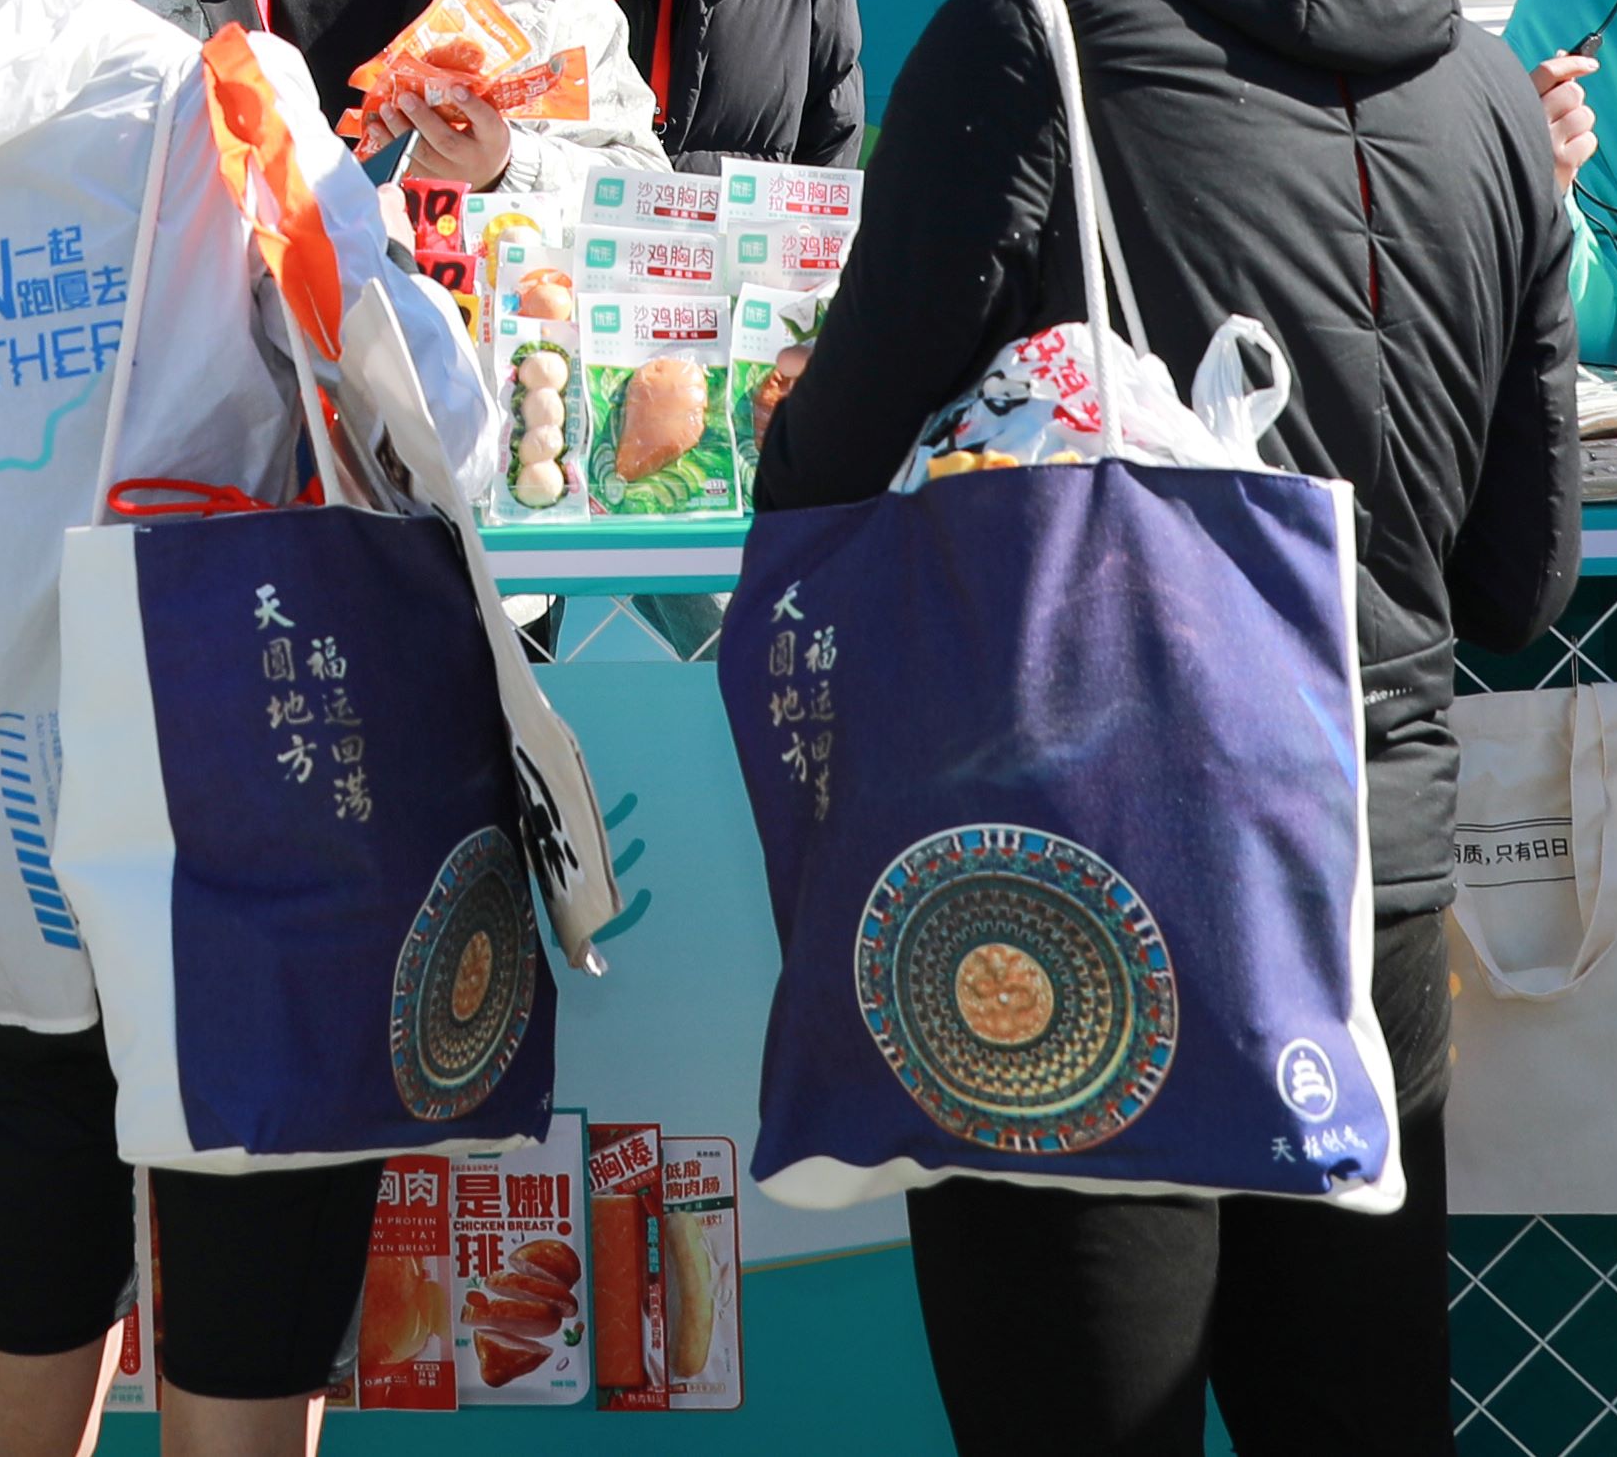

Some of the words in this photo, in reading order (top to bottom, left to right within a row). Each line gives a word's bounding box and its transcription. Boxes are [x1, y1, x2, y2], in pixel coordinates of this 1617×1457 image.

[654, 185, 718, 211] 鸡胸肉
[786, 180, 850, 204] 鸡胸肉
[15, 225, 84, 267] 一起
[647, 243, 713, 269] 鸡胸肉
[652, 306, 718, 330] 鸡胸肉
[665, 1160, 702, 1181] 低脂
[387, 1217, 437, 1226] PROTEIN
[453, 1220, 506, 1232] CHICKEN
[507, 1220, 555, 1232] BREAST
[455, 1234, 504, 1278] 排
